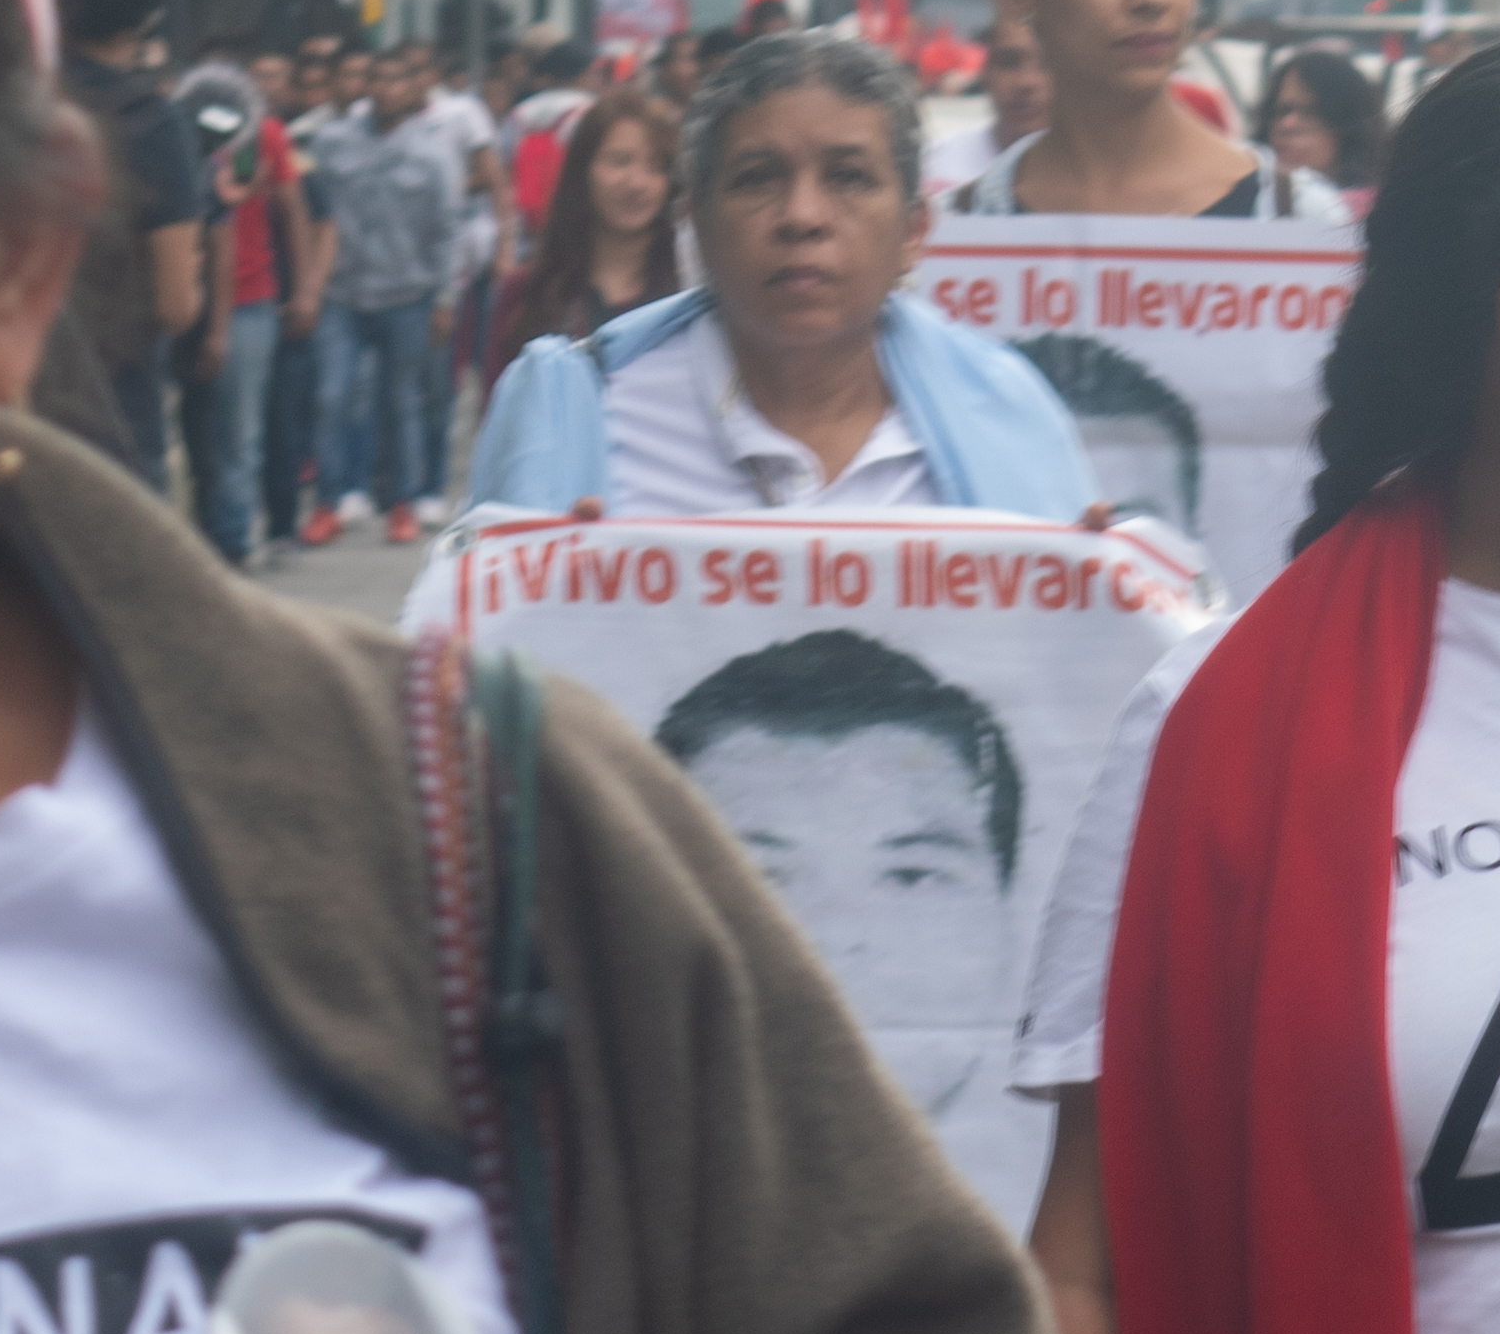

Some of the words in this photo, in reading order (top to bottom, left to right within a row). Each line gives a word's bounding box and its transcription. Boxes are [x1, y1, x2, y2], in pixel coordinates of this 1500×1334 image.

[932, 276, 997, 327] se
[1020, 267, 1077, 327] lo
[484, 532, 678, 613] ¡Vivo
[700, 547, 780, 605] se
[806, 538, 872, 607] lo
[897, 539, 1190, 613] llevaro
